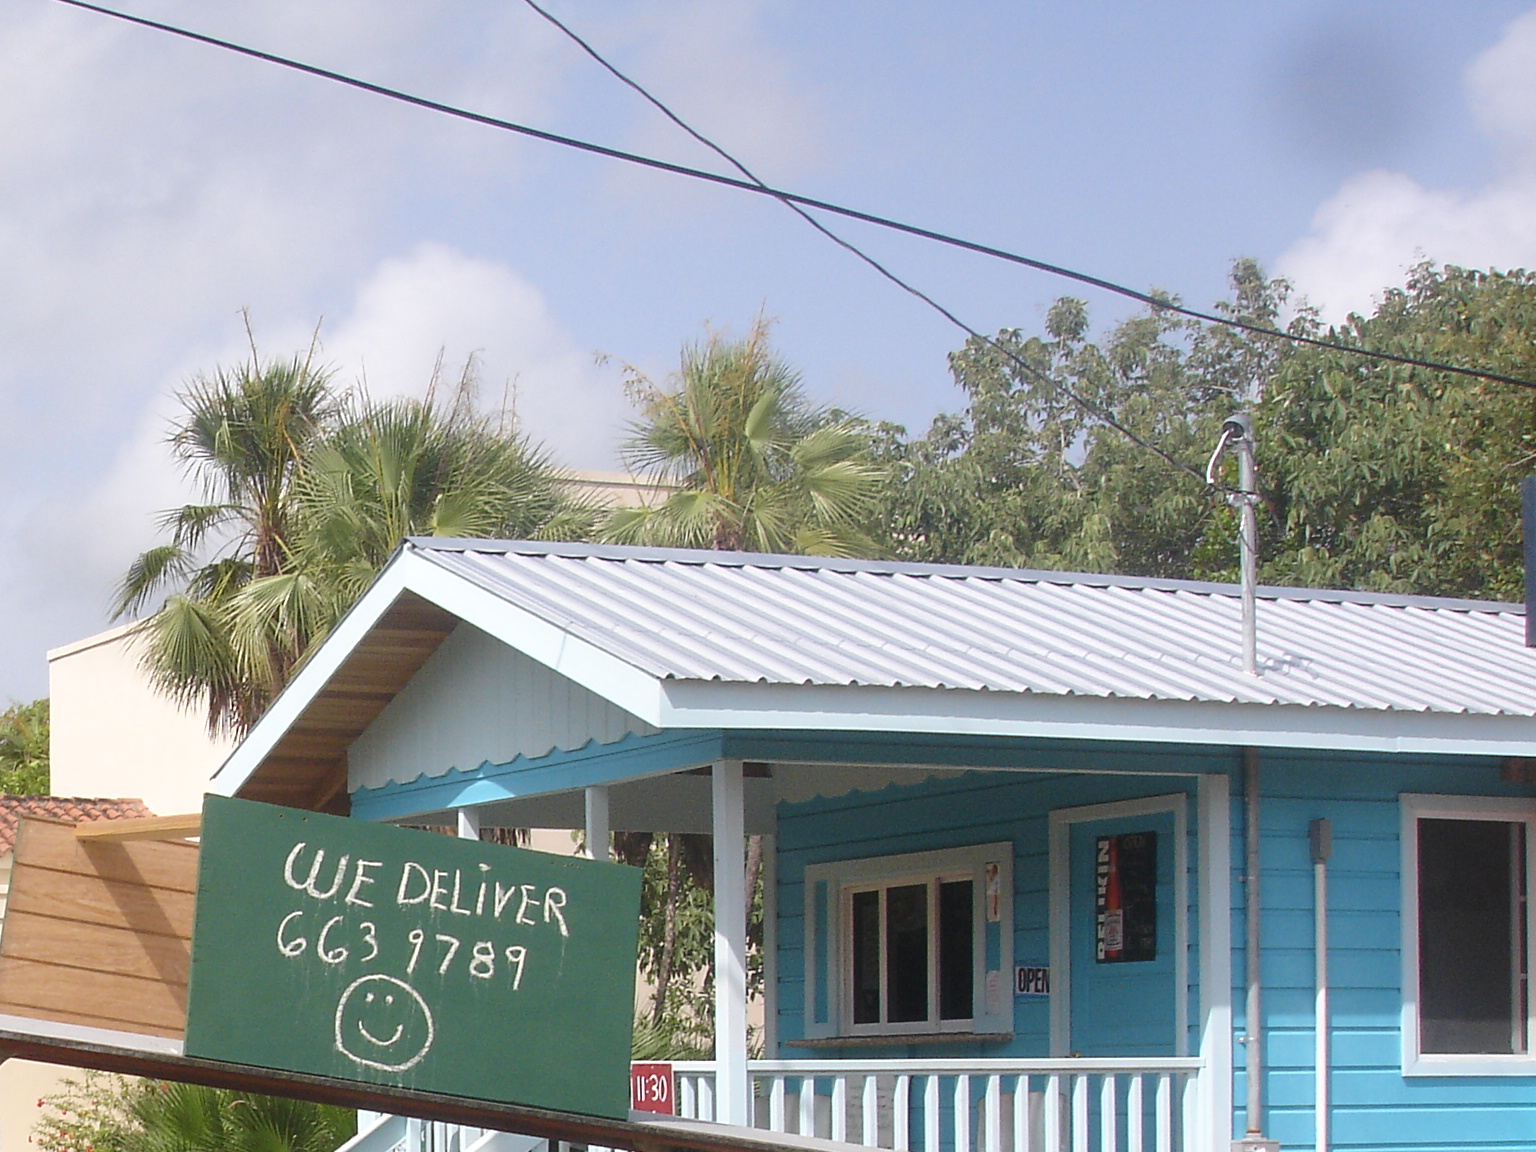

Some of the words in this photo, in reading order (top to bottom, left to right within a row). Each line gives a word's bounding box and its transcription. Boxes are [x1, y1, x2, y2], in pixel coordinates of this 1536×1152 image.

[284, 842, 383, 907] WE
[277, 911, 378, 964] 663
[407, 929, 527, 991] 9789
[1018, 968, 1050, 993] OPEN
[636, 1074, 668, 1102] 11:30
